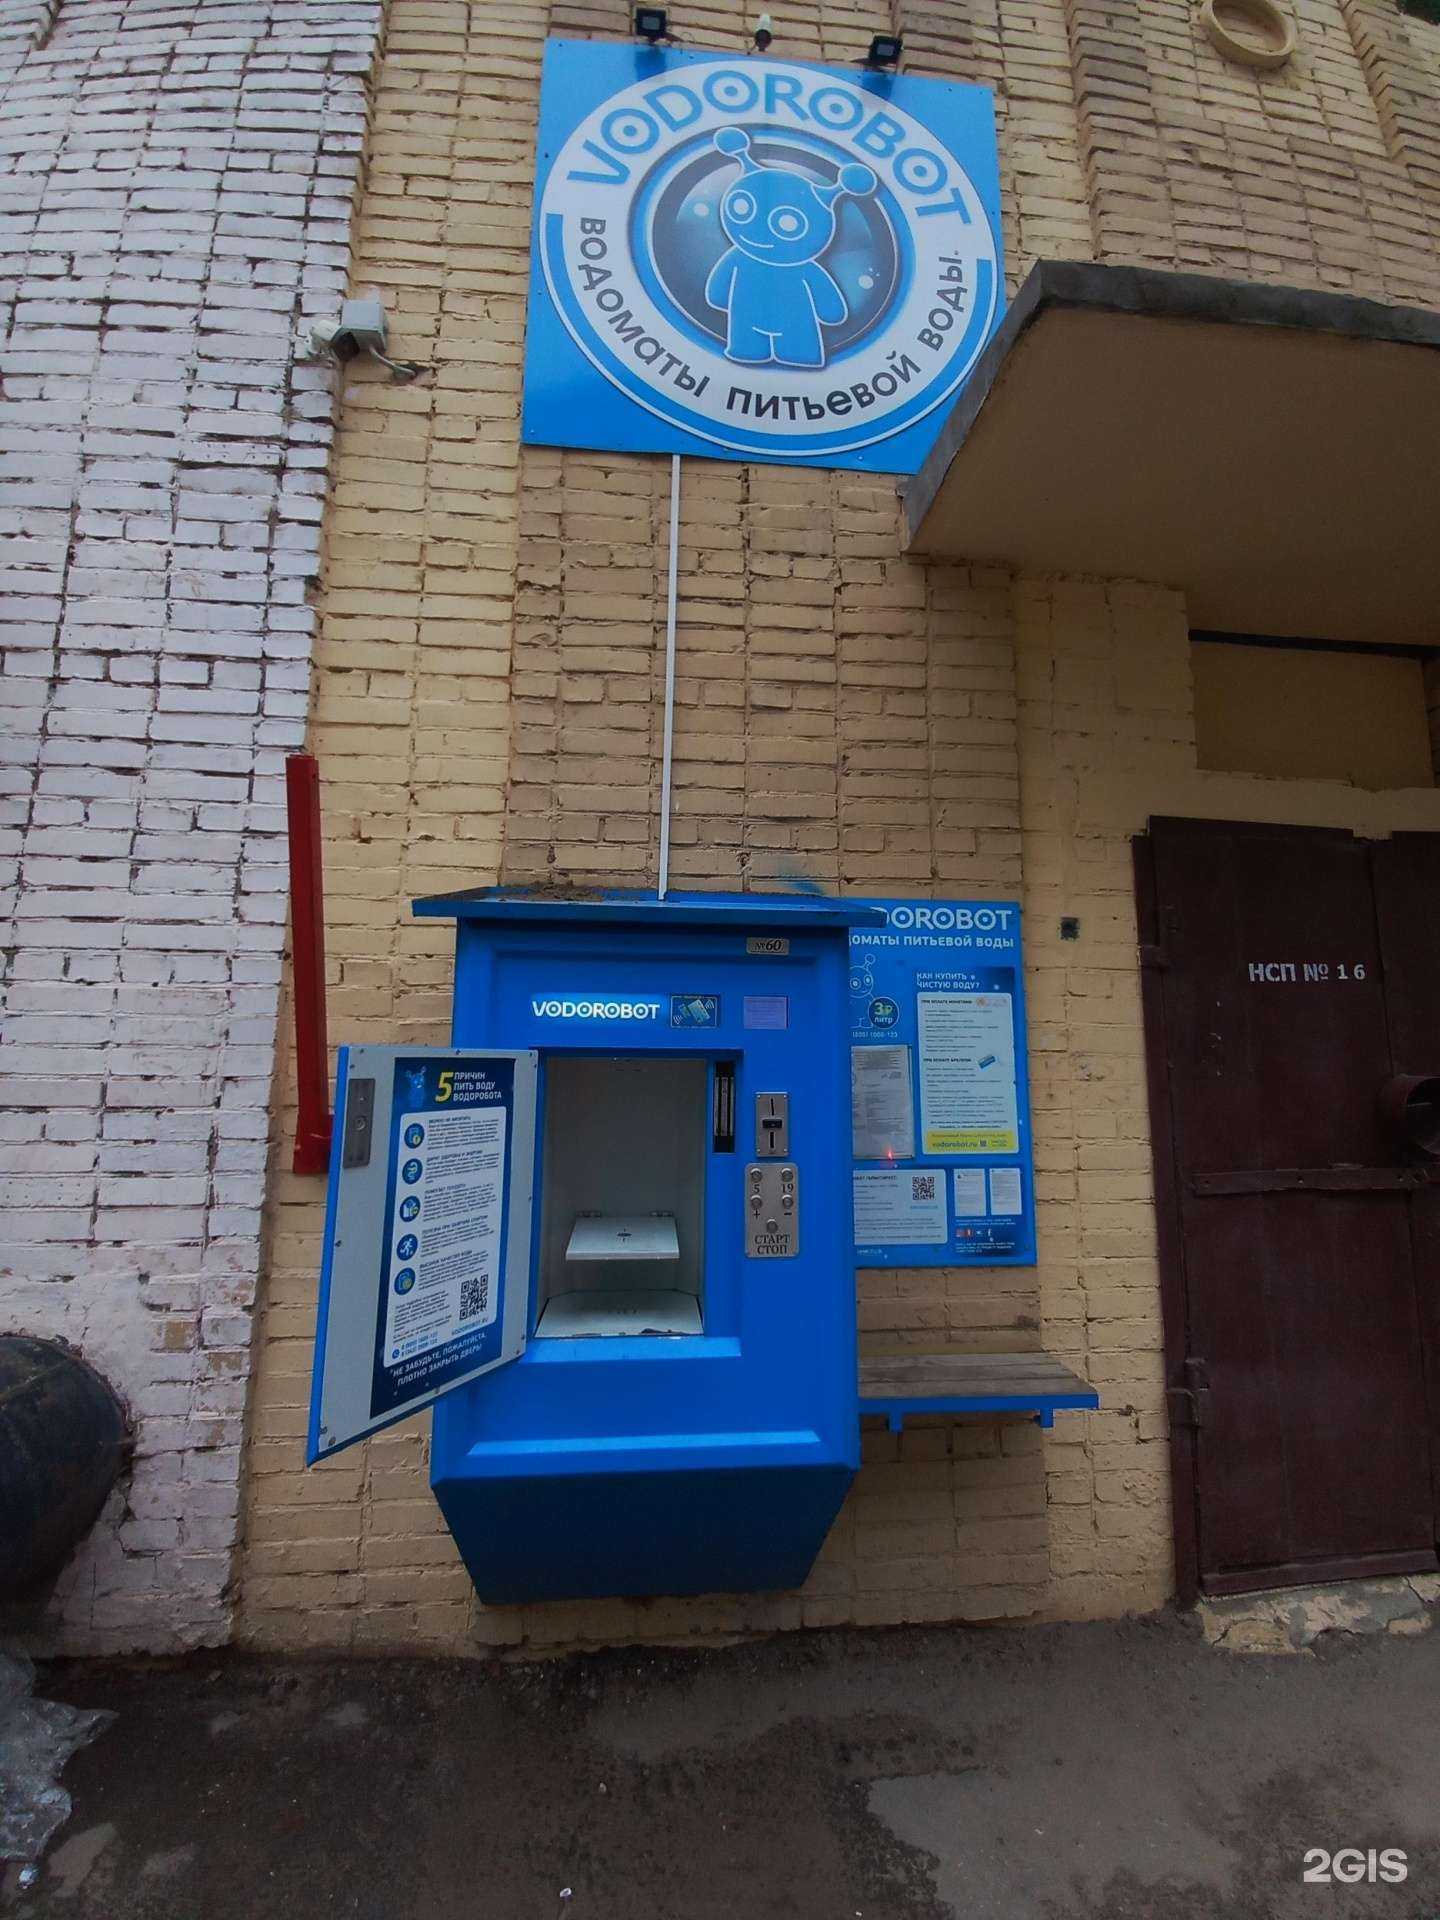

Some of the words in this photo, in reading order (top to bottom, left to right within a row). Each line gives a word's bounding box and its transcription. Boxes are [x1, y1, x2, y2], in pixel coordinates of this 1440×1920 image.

[566, 70, 972, 225] VODOROBOT
[849, 934, 900, 946] ОМАТЫ
[903, 934, 972, 948] ПИТЬЕВОЙ
[976, 937, 1014, 949] ВОДЫ
[916, 972, 934, 980] КАК
[935, 972, 967, 980] КУПИТЬ
[1248, 962, 1297, 982] НСП
[917, 981, 951, 989] ЧИСТУЮ
[532, 1001, 661, 1020] VODOROBOT
[454, 1072, 486, 1080] ПРИЧИН
[435, 1072, 454, 1102] 5
[453, 1082, 475, 1091] ПИТЬ
[475, 1081, 496, 1091] ВОДУ
[453, 1091, 502, 1102] ВОДОРОБОТА
[754, 1184, 760, 1193] 5
[781, 1183, 794, 1193] 19
[755, 1235, 790, 1245] СТАРТ
[757, 1245, 787, 1255] СТОП
